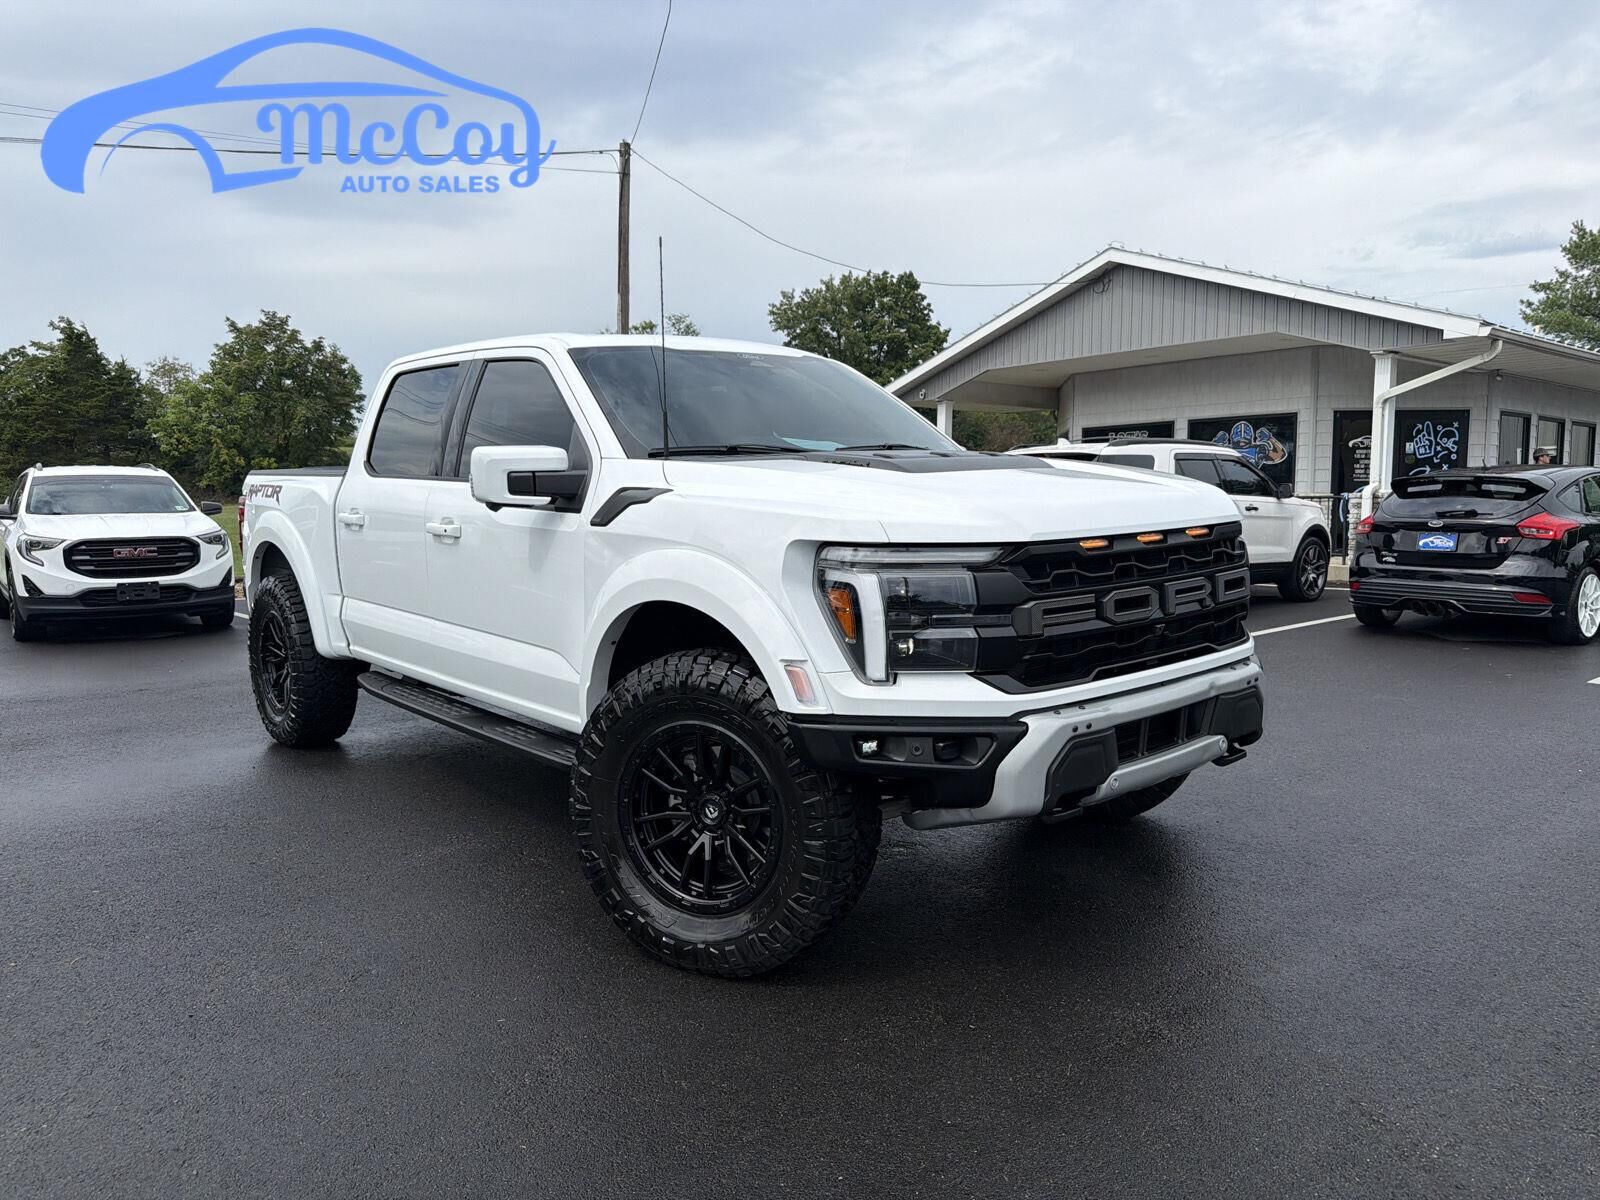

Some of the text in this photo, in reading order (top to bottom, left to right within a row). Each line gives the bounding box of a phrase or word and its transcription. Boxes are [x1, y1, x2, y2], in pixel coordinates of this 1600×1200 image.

[248, 484, 283, 506] RAPTOR
[112, 547, 158, 558] GMC
[1010, 567, 1250, 641] FORD
